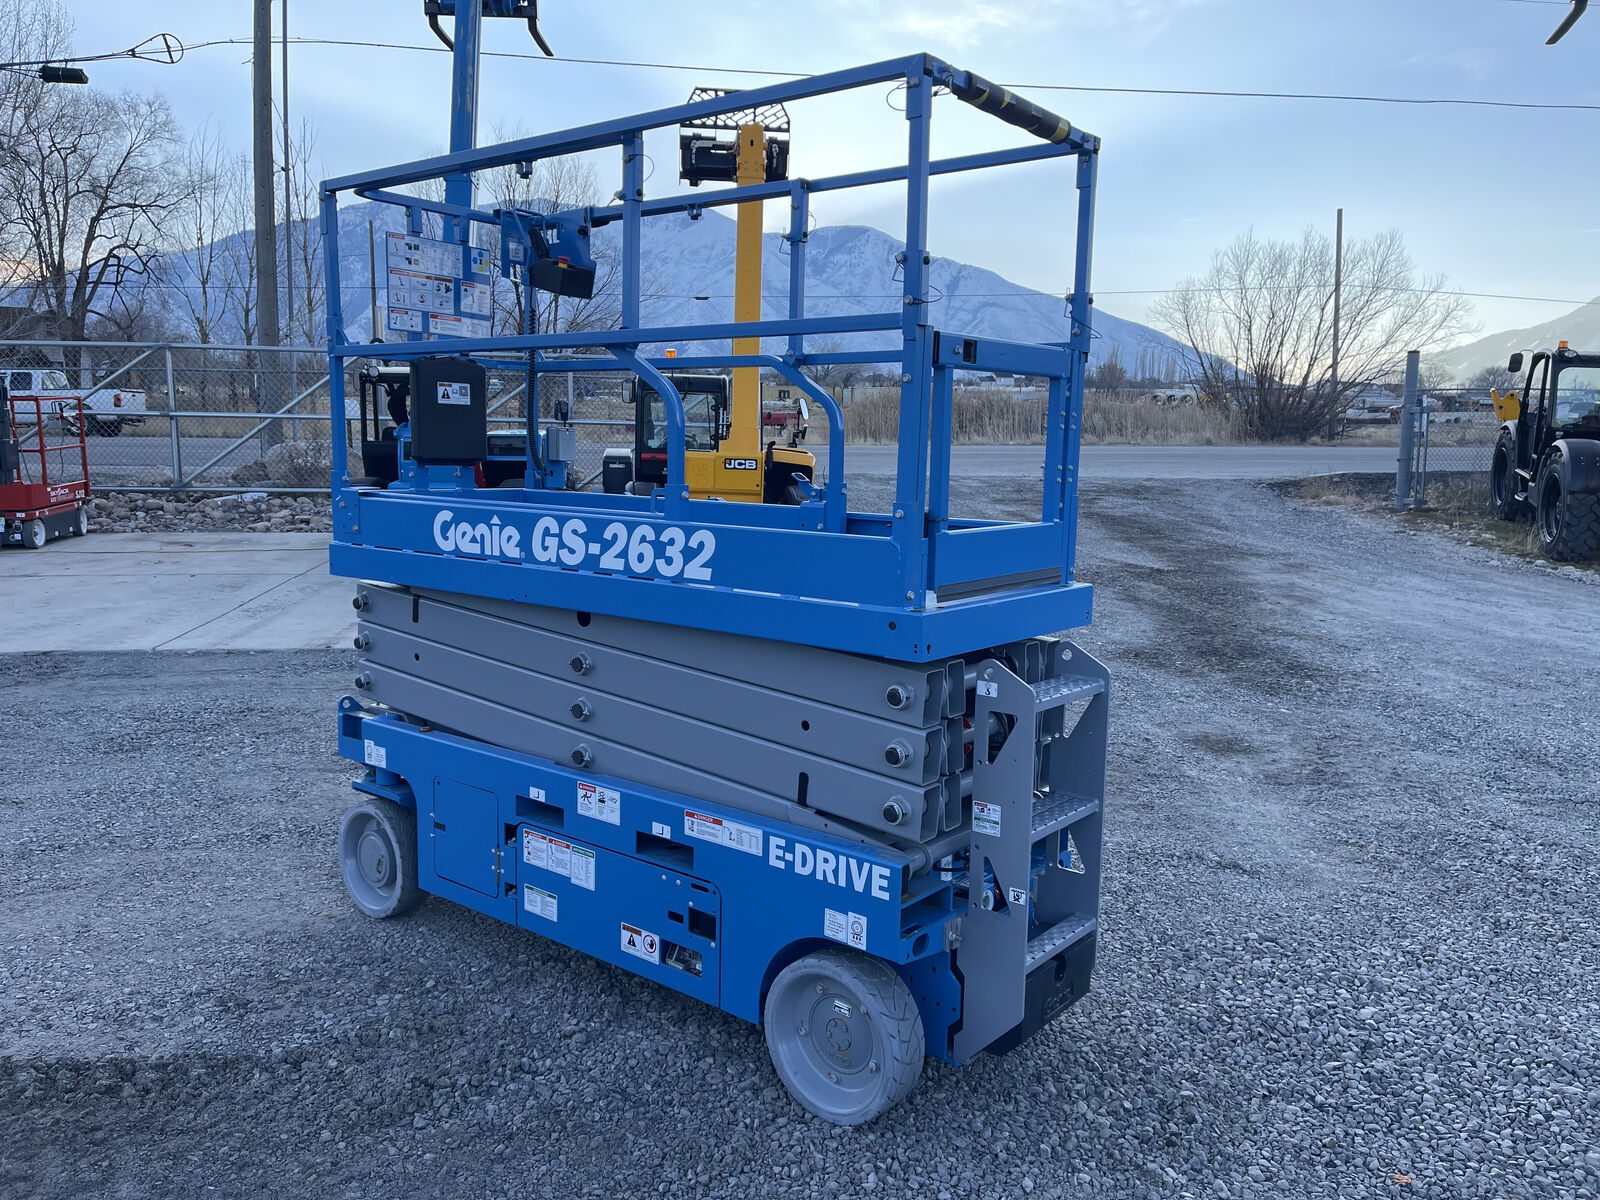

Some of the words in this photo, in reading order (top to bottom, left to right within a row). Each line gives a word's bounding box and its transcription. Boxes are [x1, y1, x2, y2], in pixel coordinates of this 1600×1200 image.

[725, 459, 757, 470] JCB
[433, 510, 521, 558] Genie
[532, 516, 716, 581] GS-2632
[769, 835, 891, 901] E-DRIVE
